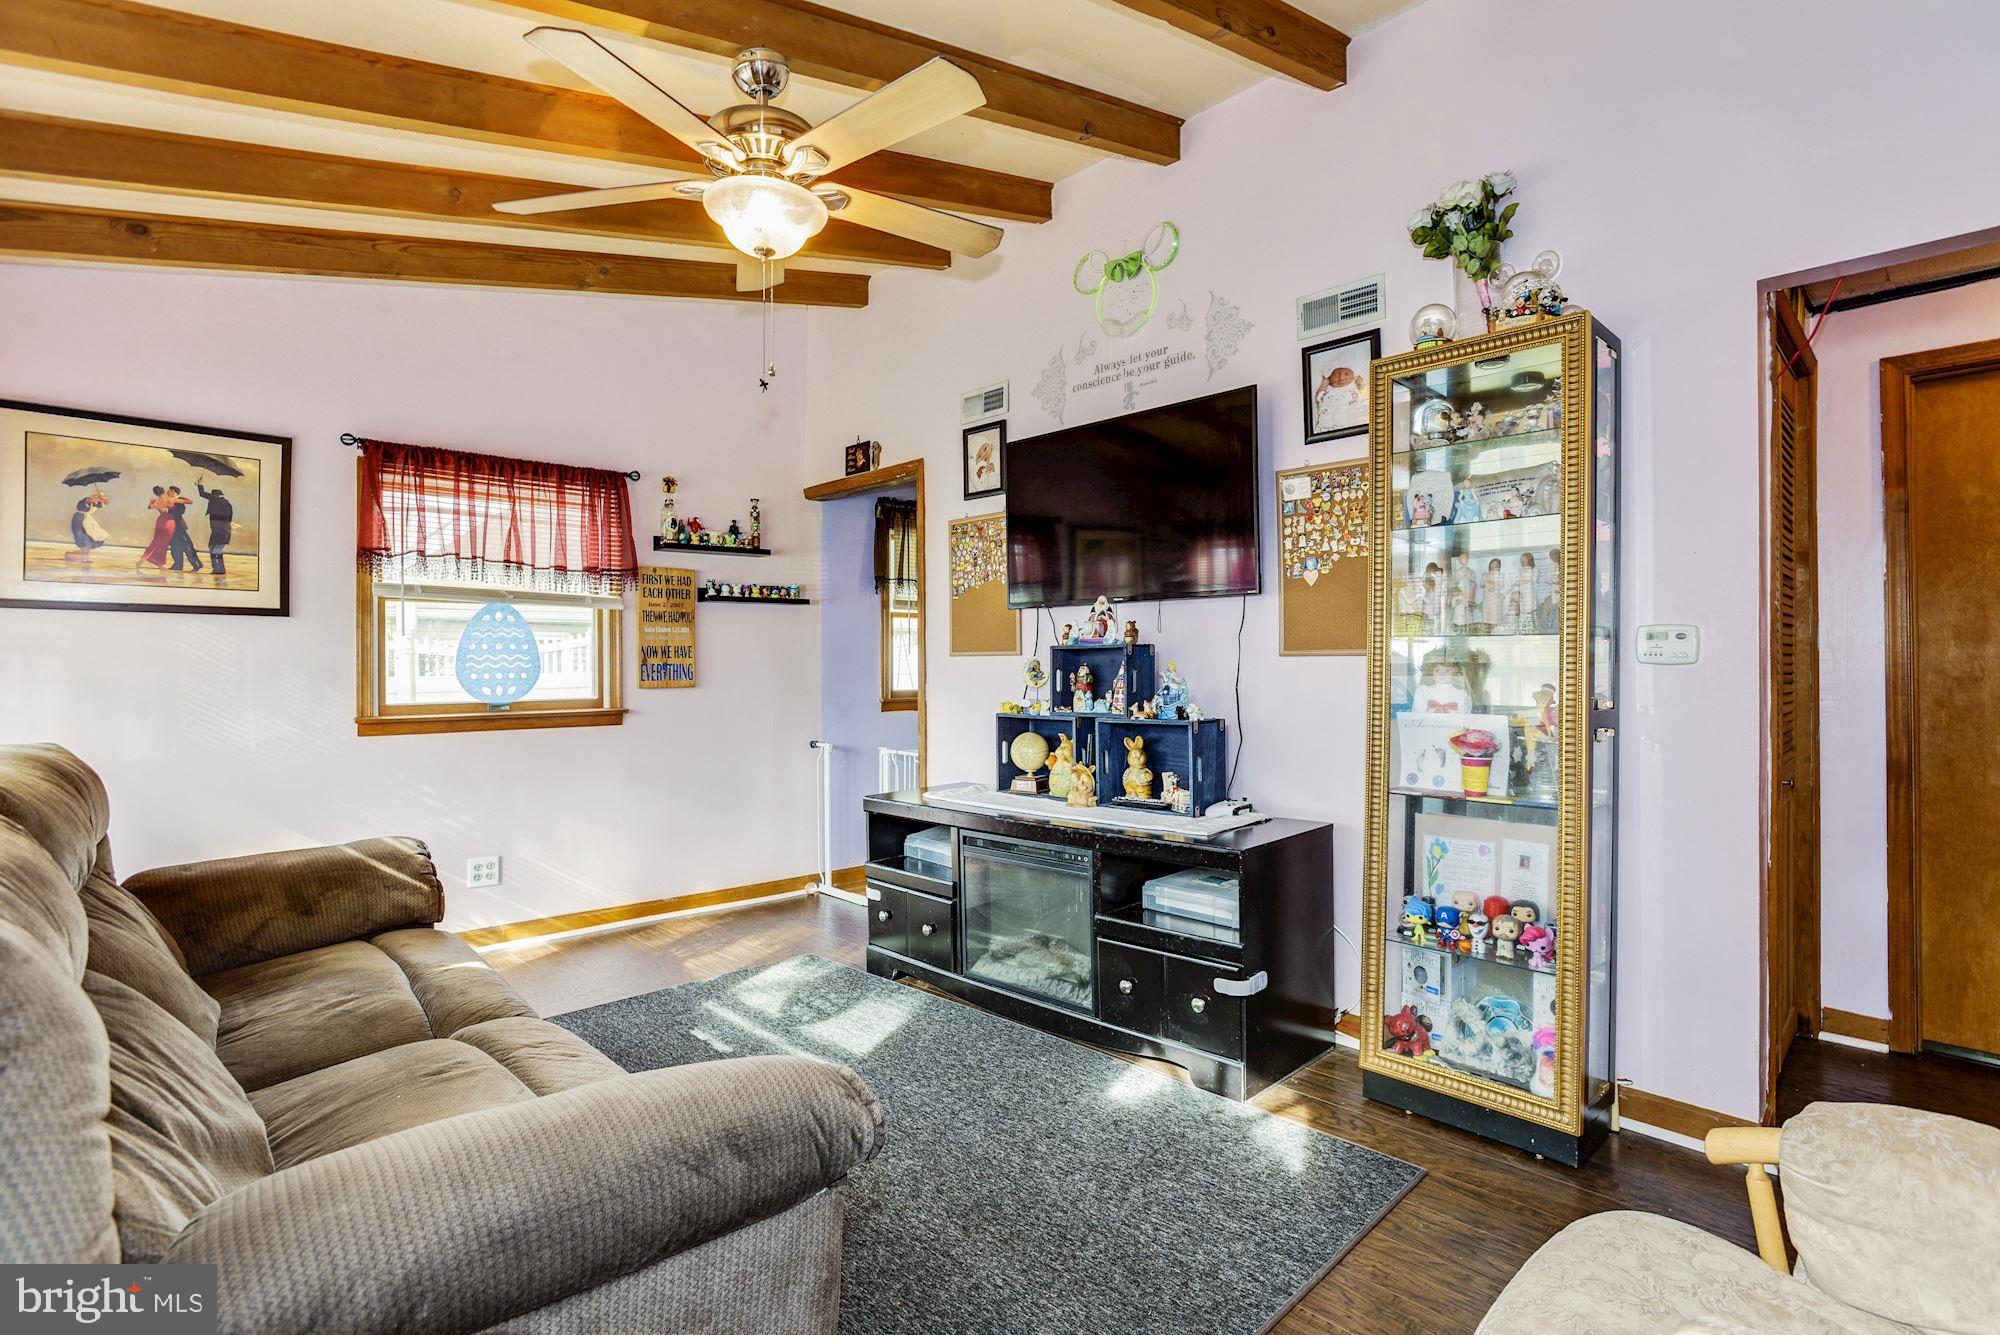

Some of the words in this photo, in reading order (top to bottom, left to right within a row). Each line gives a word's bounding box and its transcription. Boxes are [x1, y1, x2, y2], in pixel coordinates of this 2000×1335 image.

[1094, 358, 1126, 375] Always
[1130, 353, 1141, 364] let
[1145, 346, 1169, 362] your
[1072, 373, 1121, 393] conscience
[1123, 368, 1135, 378] be
[1137, 361, 1161, 376] your
[1164, 351, 1196, 370] guide.
[641, 574, 663, 585] FIRST
[664, 575, 675, 586] WE
[677, 576, 692, 587] HAD
[642, 587, 663, 599] EACH
[665, 588, 691, 600] OTHER
[642, 610, 656, 623] THEN
[656, 610, 668, 623] WE
[668, 611, 680, 623] HAD
[641, 645, 659, 659] NOW
[660, 645, 672, 659] WE
[674, 645, 693, 659] HAVE
[640, 663, 694, 682] EVERYTHING
[1440, 911, 1449, 920] A
